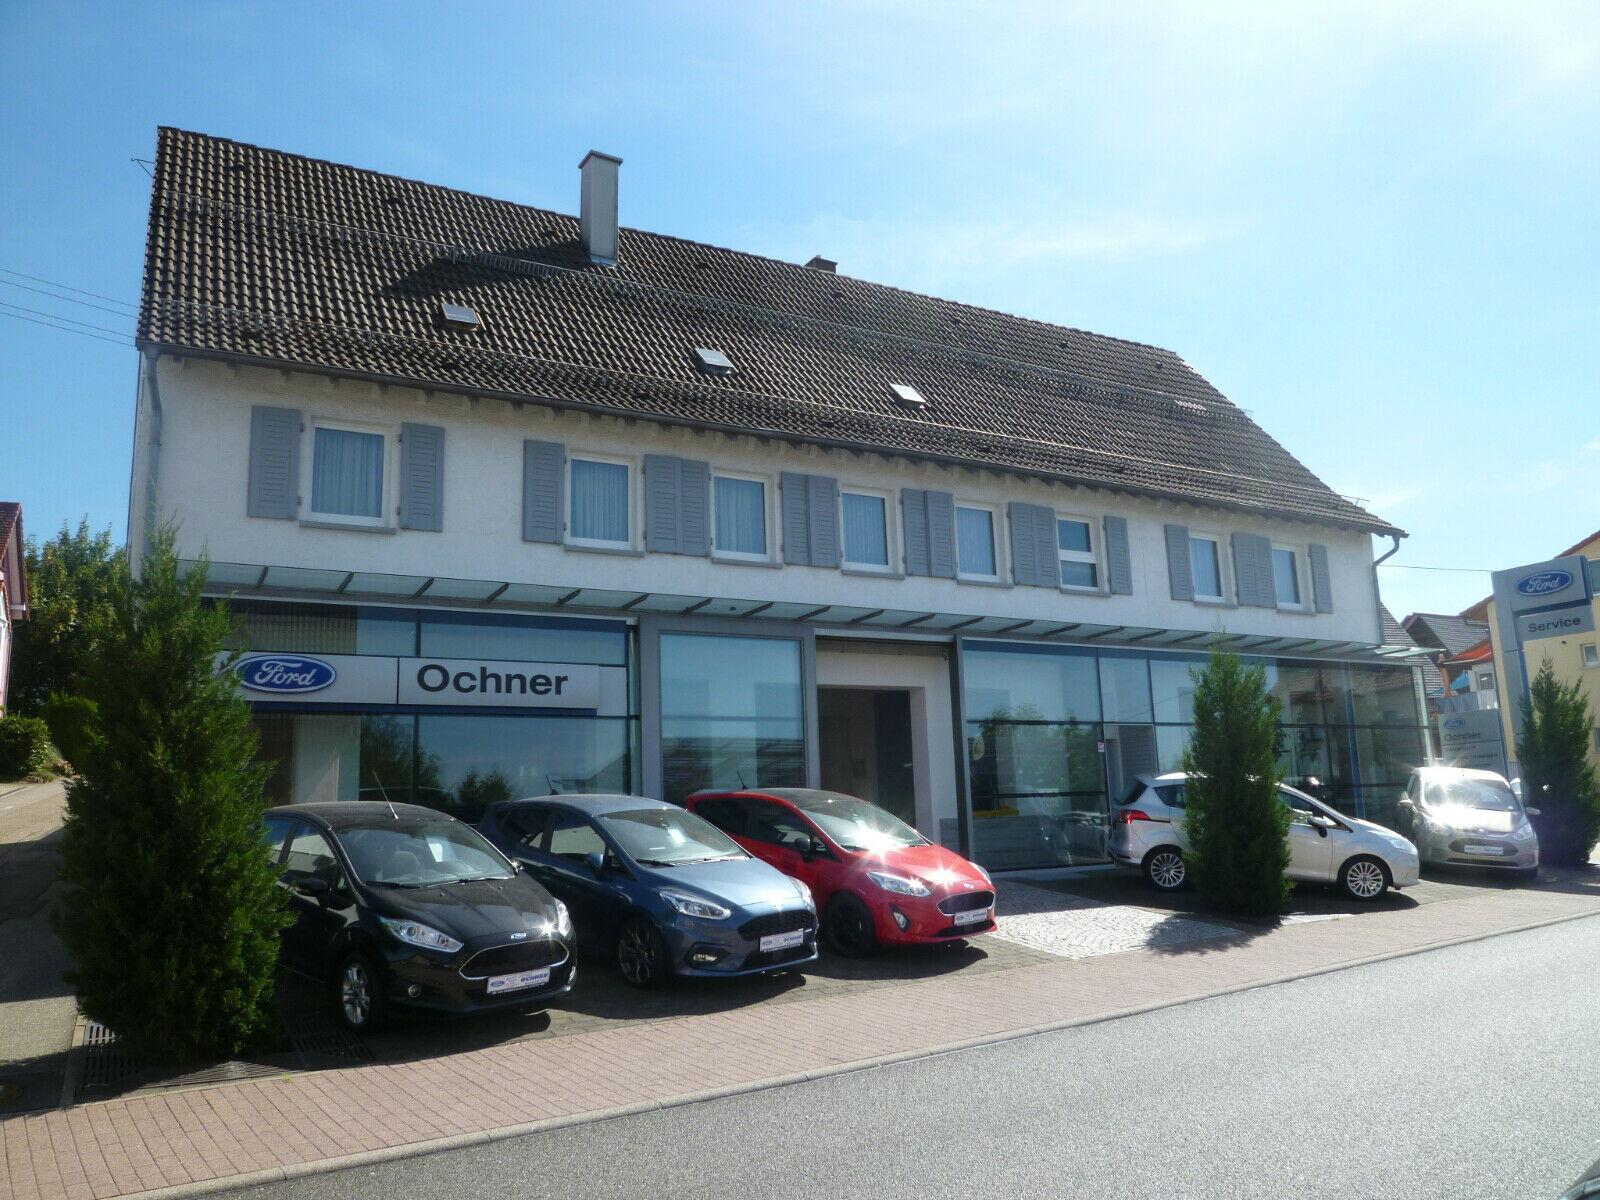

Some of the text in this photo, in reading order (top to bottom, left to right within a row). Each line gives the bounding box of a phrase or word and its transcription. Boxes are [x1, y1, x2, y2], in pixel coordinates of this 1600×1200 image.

[1527, 575, 1560, 592] Ford
[1528, 617, 1581, 632] Service
[254, 660, 317, 686] Ford
[417, 664, 568, 695] Ochner
